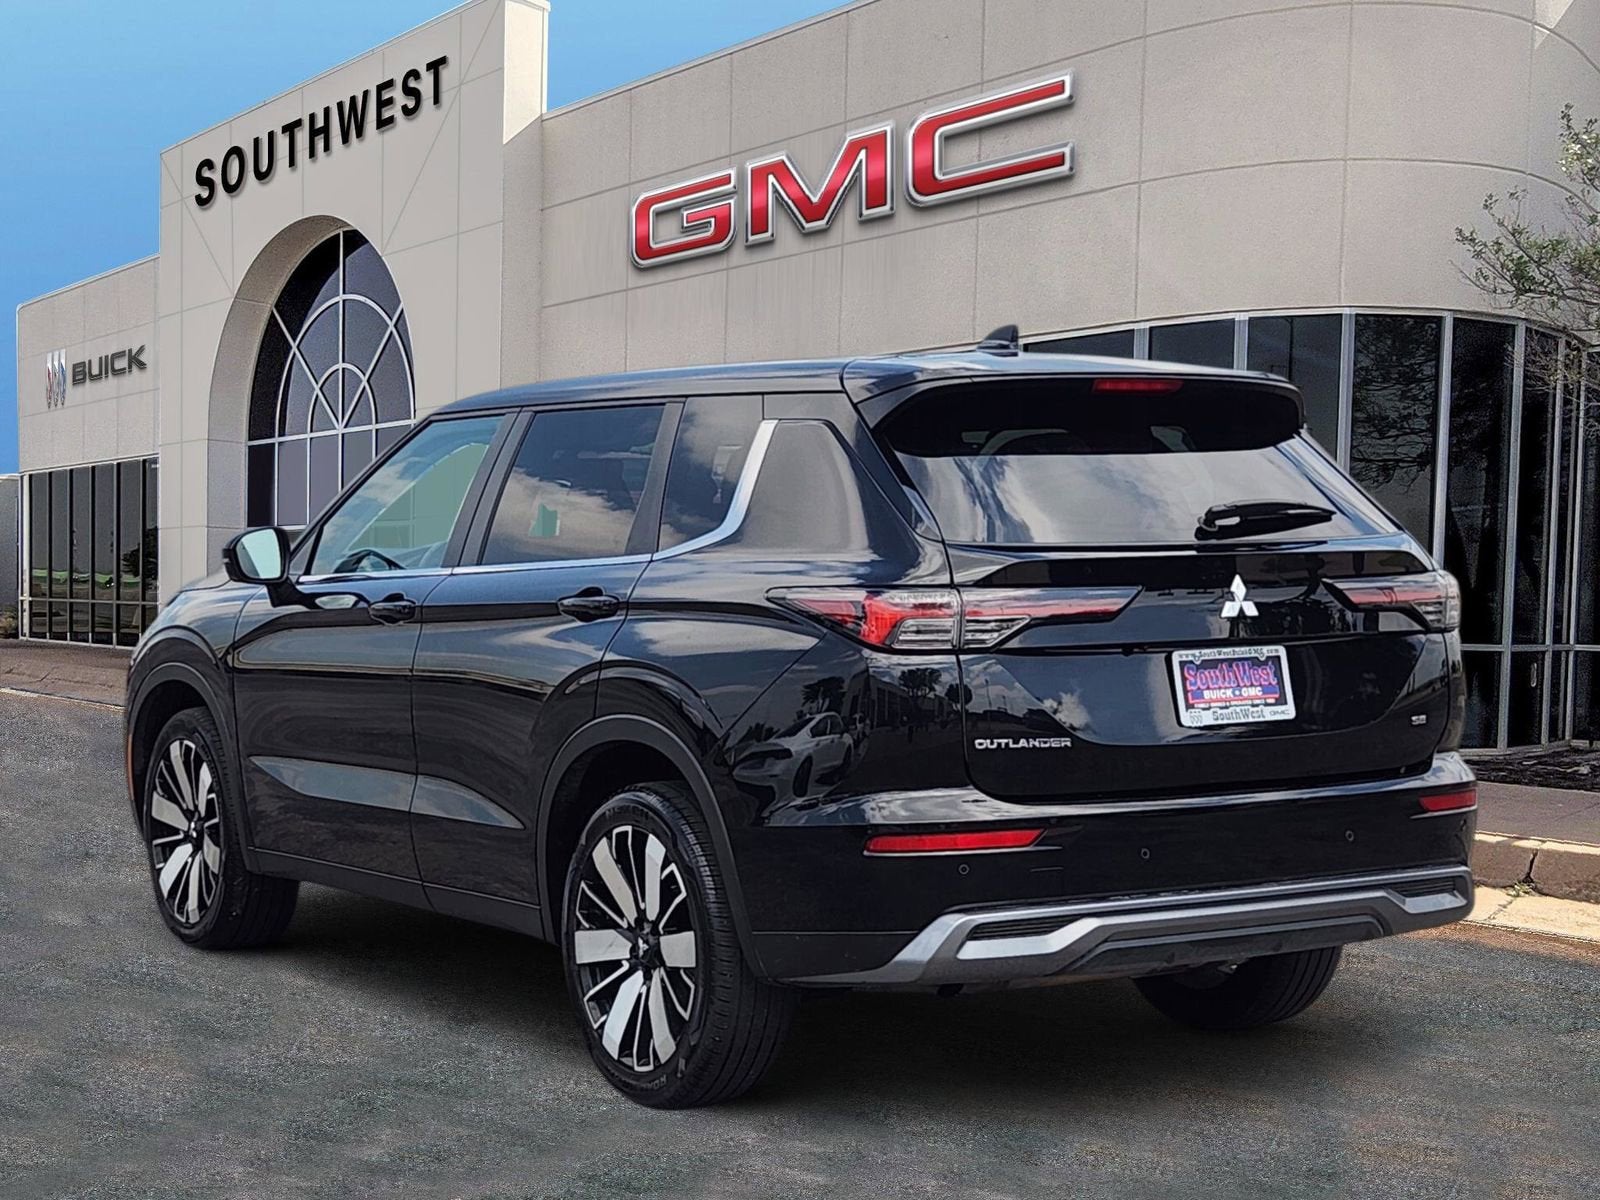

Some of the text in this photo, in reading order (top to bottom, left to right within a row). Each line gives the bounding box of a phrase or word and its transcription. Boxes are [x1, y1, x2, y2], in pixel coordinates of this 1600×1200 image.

[195, 55, 447, 207] SOUTHWEST
[630, 69, 1075, 268] GMC
[72, 344, 147, 386] BUICK
[1203, 687, 1263, 699] BUICK GMC
[974, 737, 1072, 749] OUTLANDER
